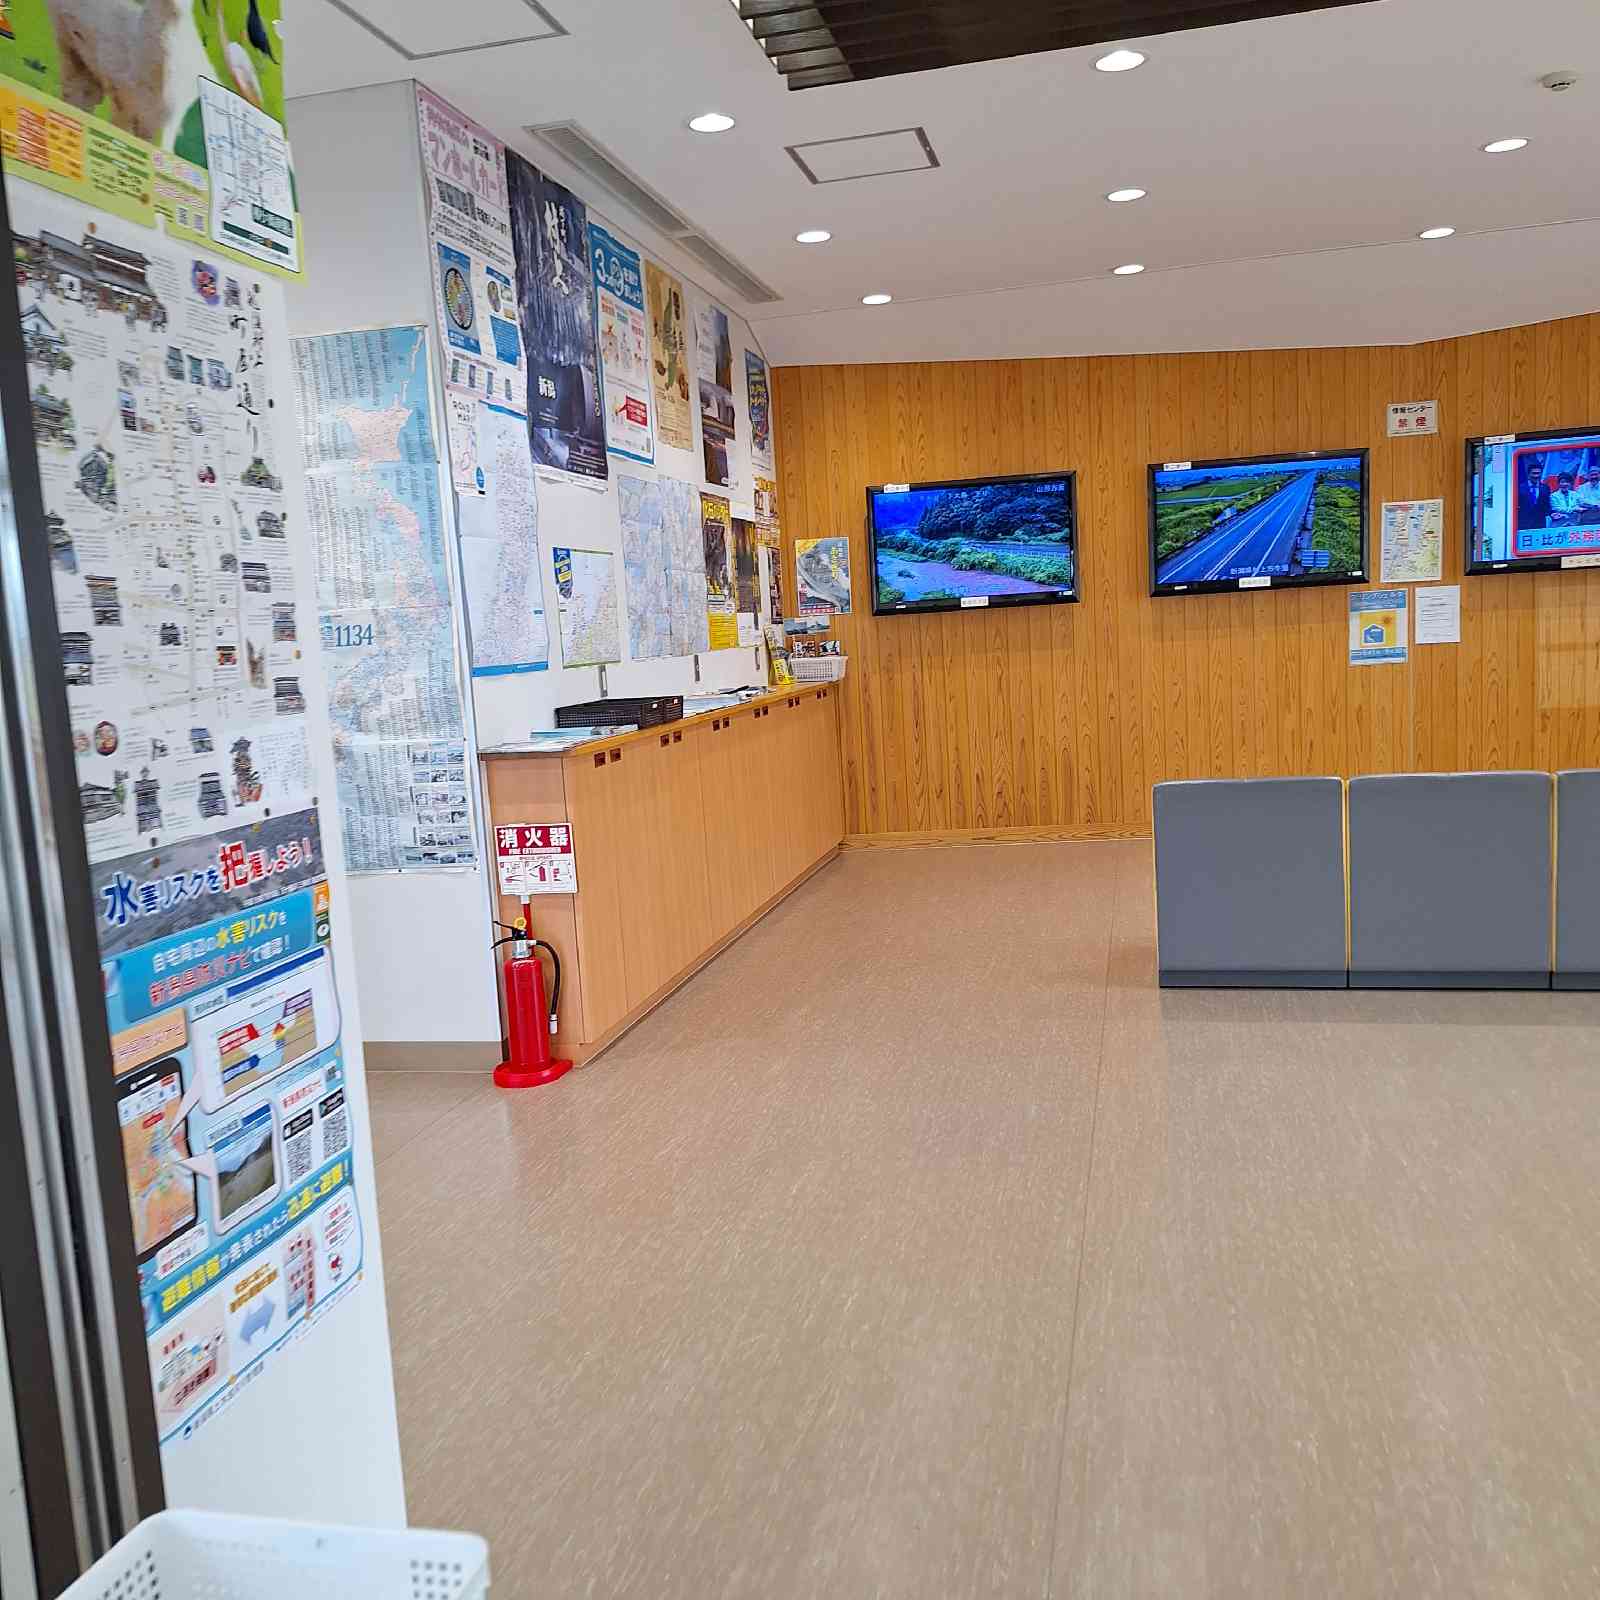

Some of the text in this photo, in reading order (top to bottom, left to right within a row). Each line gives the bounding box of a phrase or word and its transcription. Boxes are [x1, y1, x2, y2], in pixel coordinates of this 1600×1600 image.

[335, 623, 374, 647] 1134
[498, 827, 569, 849] 消火器
